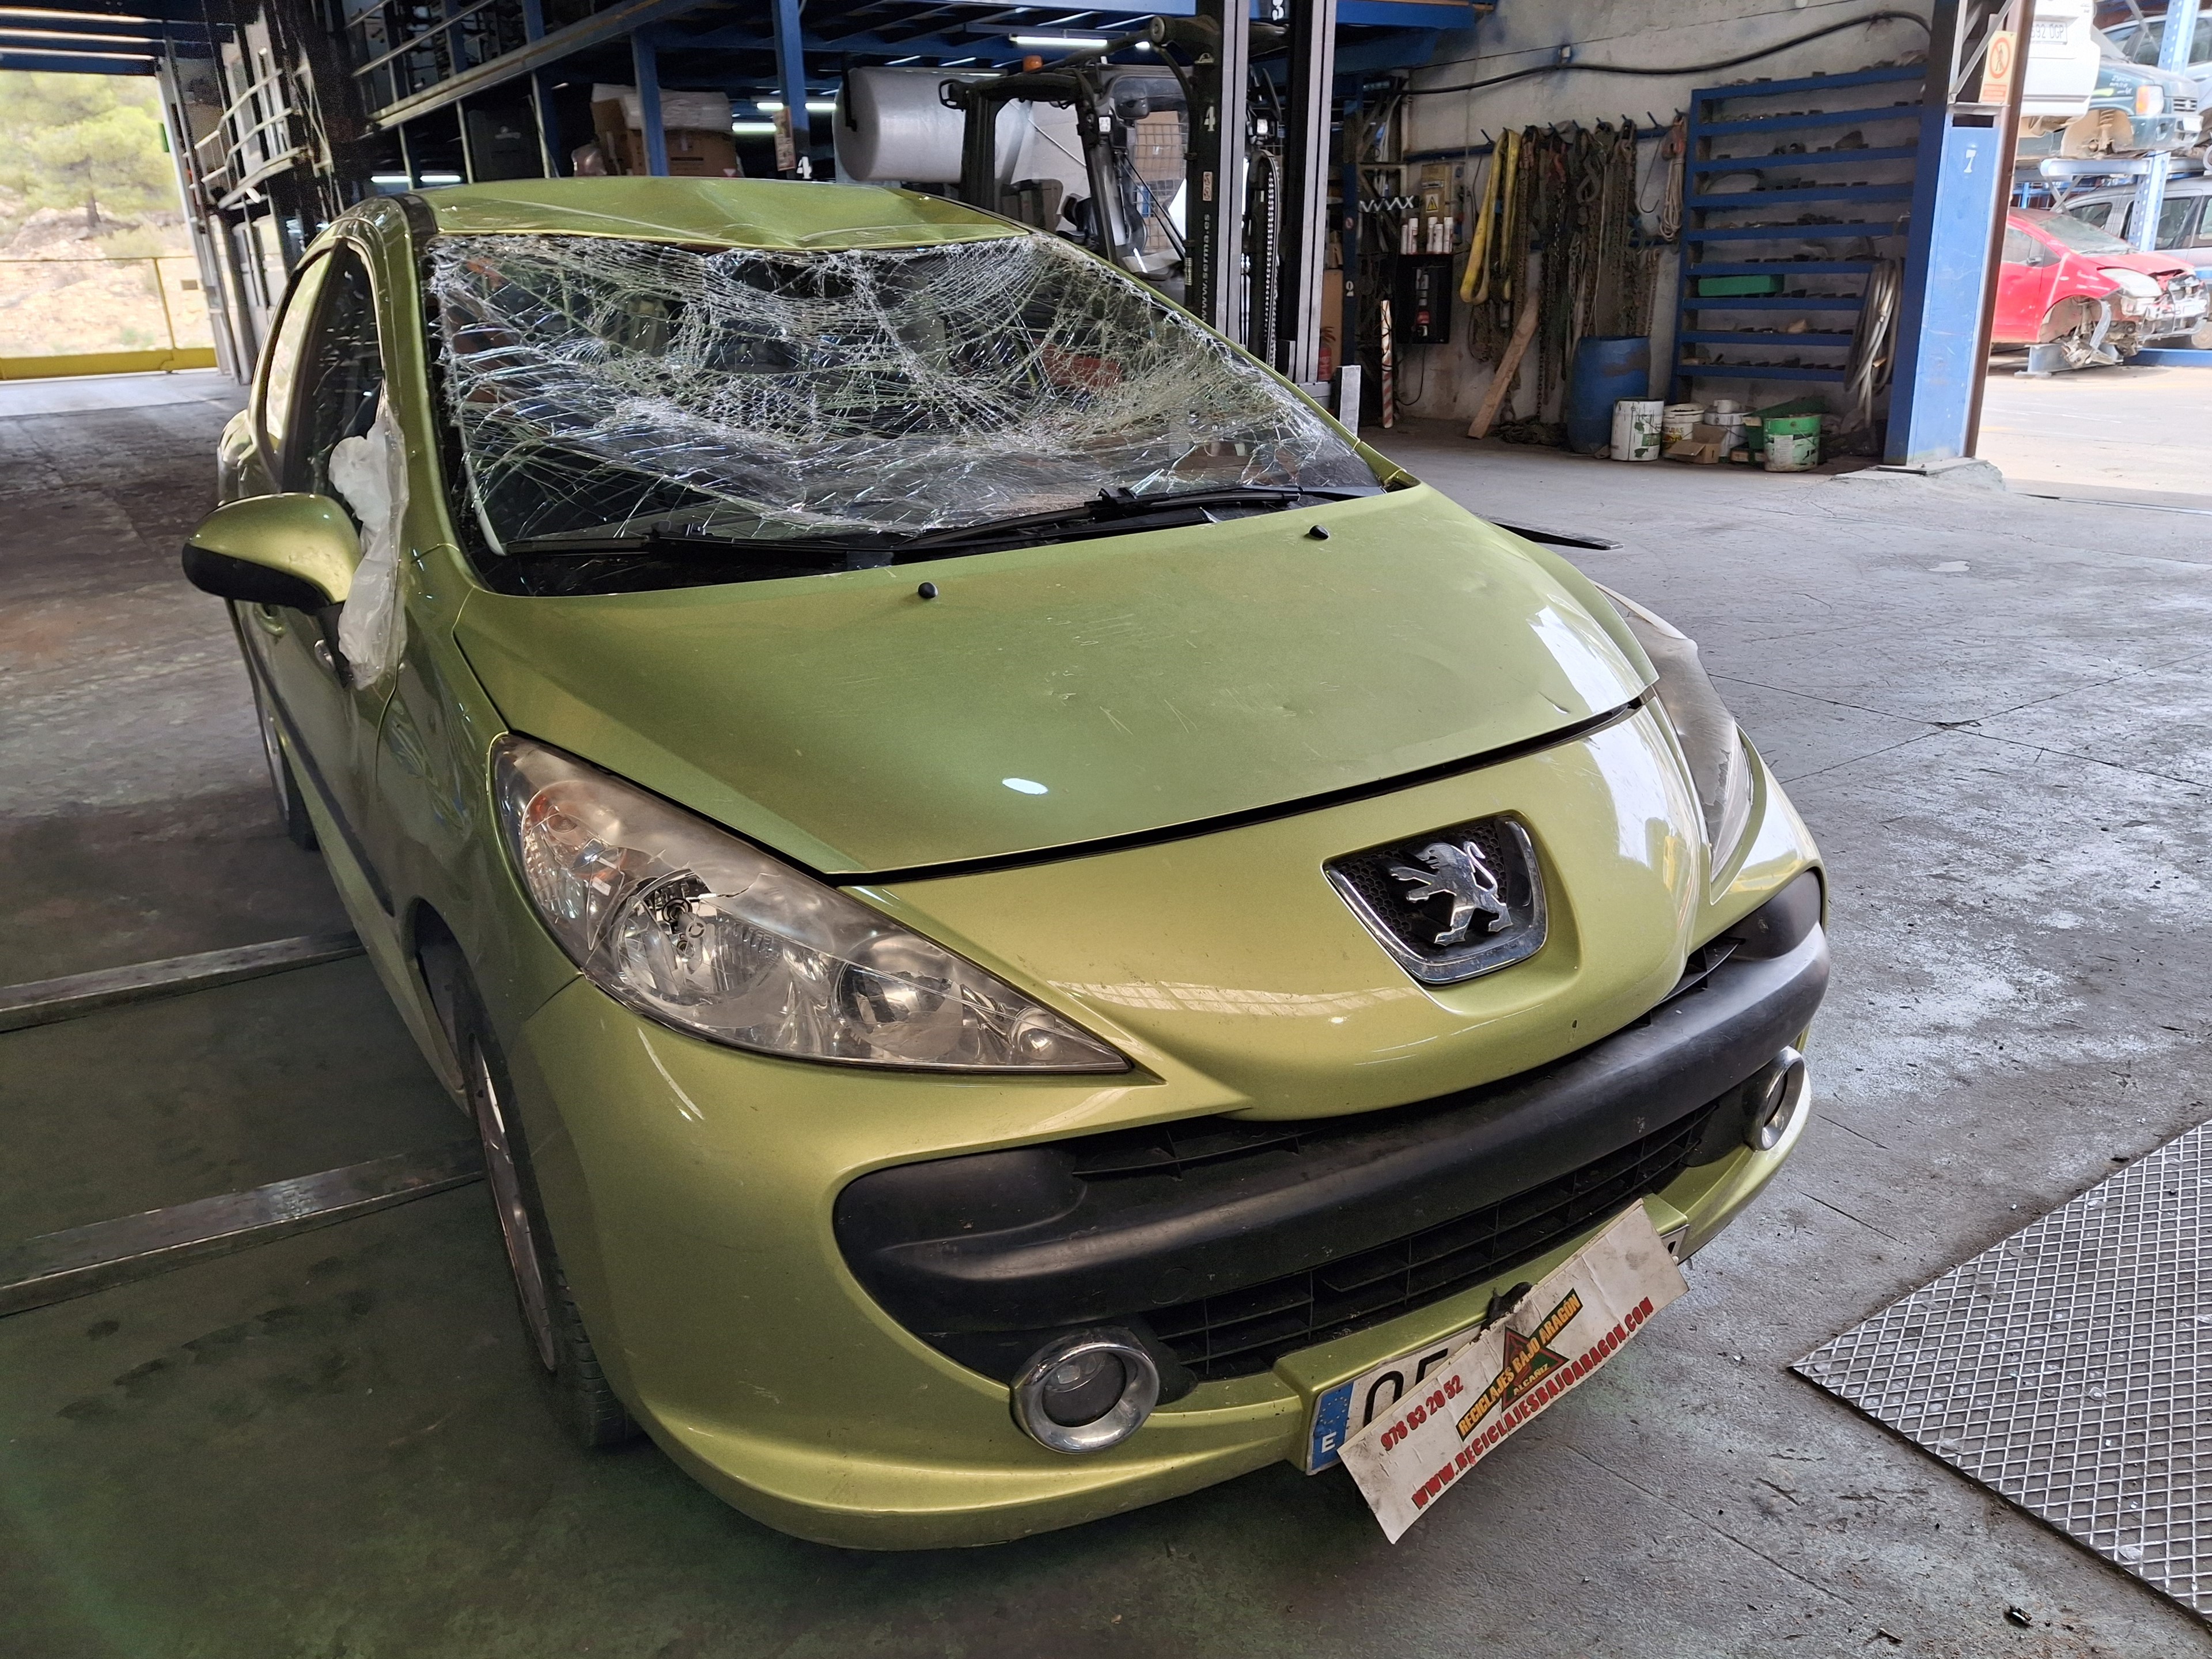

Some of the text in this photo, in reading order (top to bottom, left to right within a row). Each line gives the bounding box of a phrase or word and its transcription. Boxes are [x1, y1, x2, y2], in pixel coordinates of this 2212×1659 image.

[1203, 106, 1216, 132] 4
[796, 156, 813, 180] 4
[1202, 214, 1210, 321] www.serma.es
[1345, 281, 1354, 297] 2
[1458, 1294, 1581, 1435] RECICLAJES BAJO ARAGÓN
[1513, 1363, 1550, 1396] ALCAÑIZ
[1380, 1374, 1464, 1451] 978 83 20 52
[1411, 1296, 1654, 1510] WWW.RECICLAJESBAJOARAGON.COM
[1321, 1431, 1337, 1453] E
